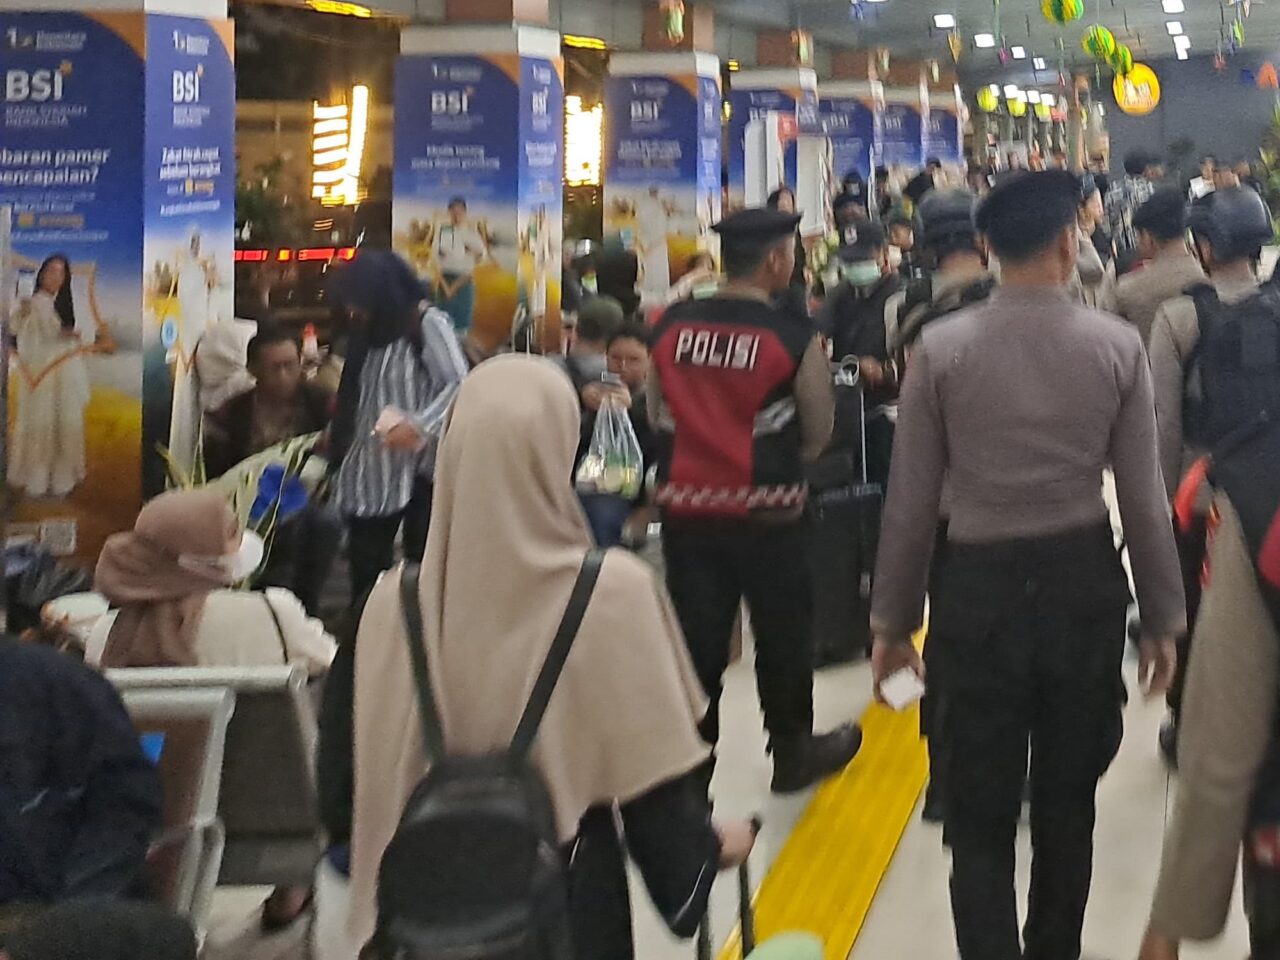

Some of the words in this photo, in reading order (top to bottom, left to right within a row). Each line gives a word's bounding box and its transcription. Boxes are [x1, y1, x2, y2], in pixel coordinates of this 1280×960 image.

[6, 70, 64, 102] BSI
[172, 71, 199, 103] BSI
[431, 92, 468, 115] BSI
[54, 148, 111, 168] pamer
[674, 328, 761, 371] POLISI
